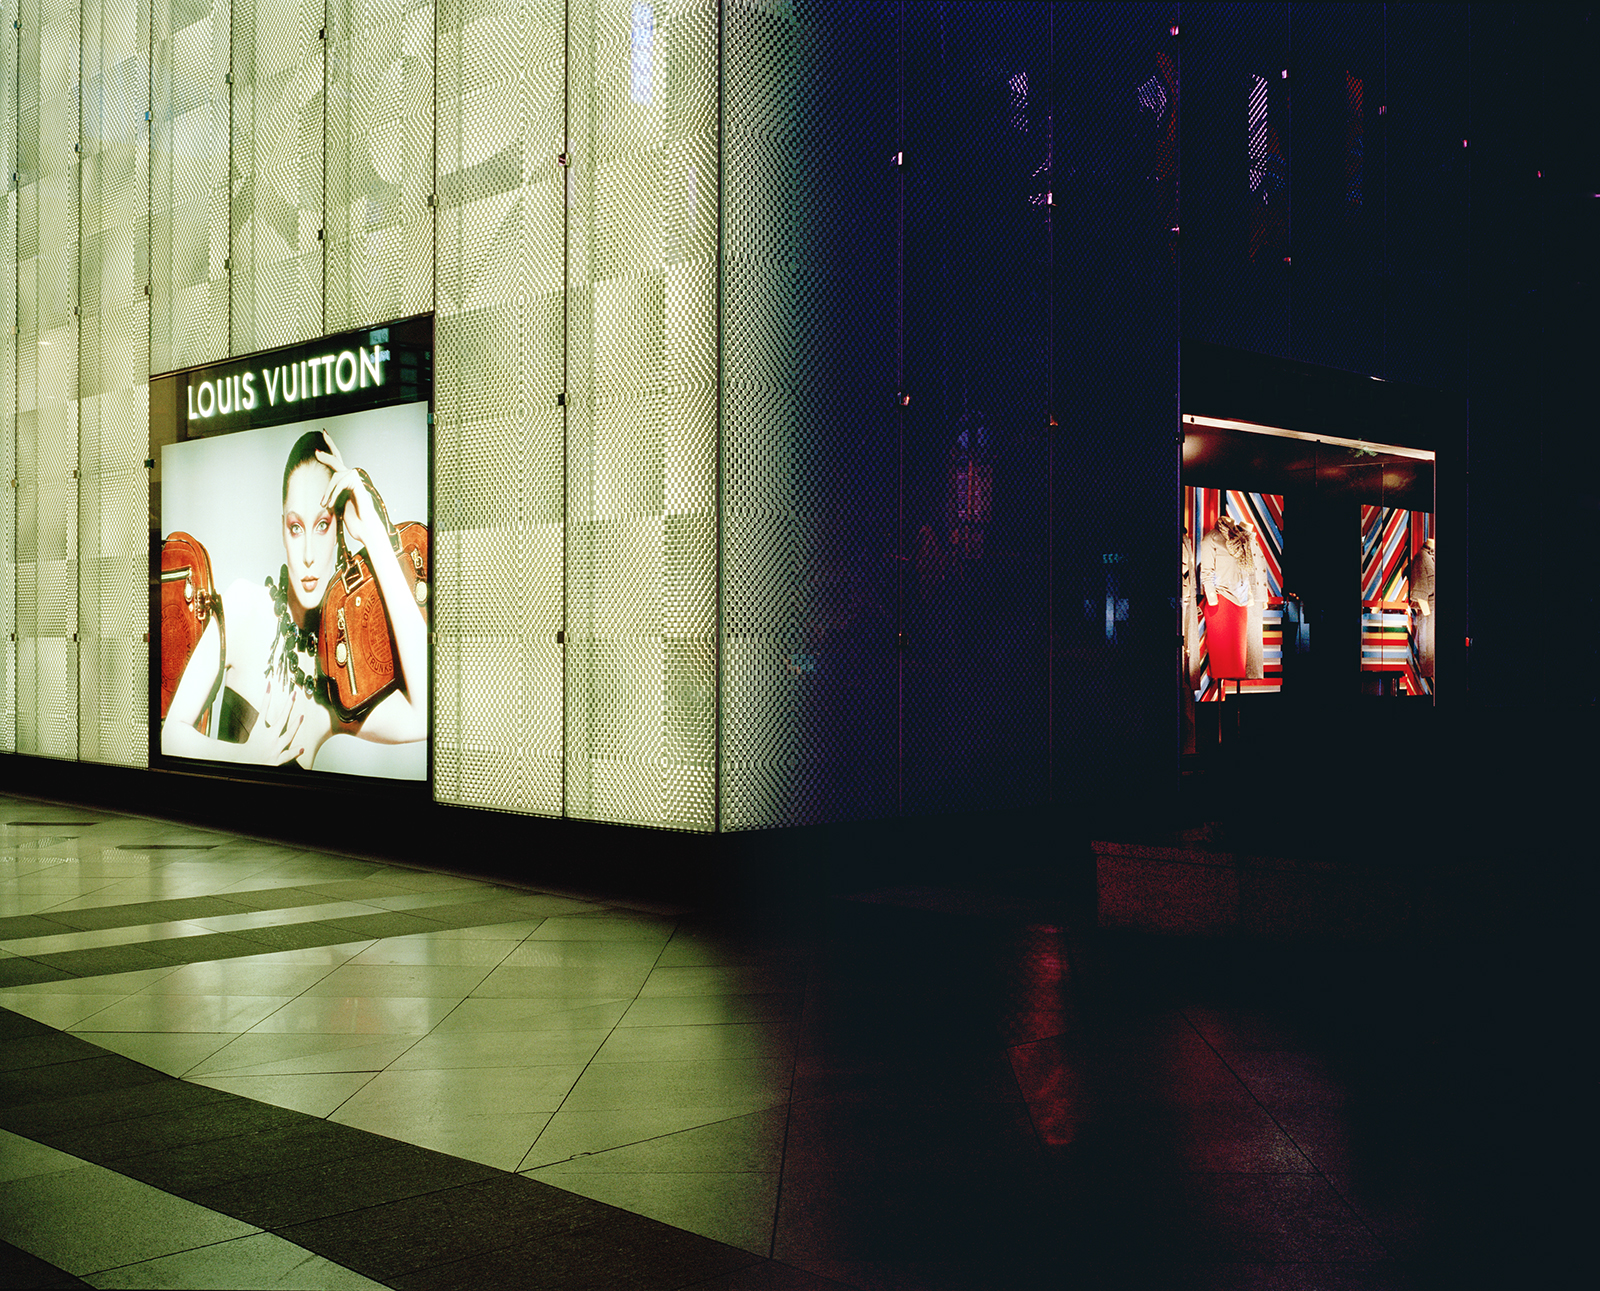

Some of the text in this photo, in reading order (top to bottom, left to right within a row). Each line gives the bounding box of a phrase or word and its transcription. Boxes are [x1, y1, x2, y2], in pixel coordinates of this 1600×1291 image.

[187, 345, 382, 420] LOUIS VUITTON
[362, 594, 376, 629] LOUIS
[367, 652, 393, 673] TRUNKS
